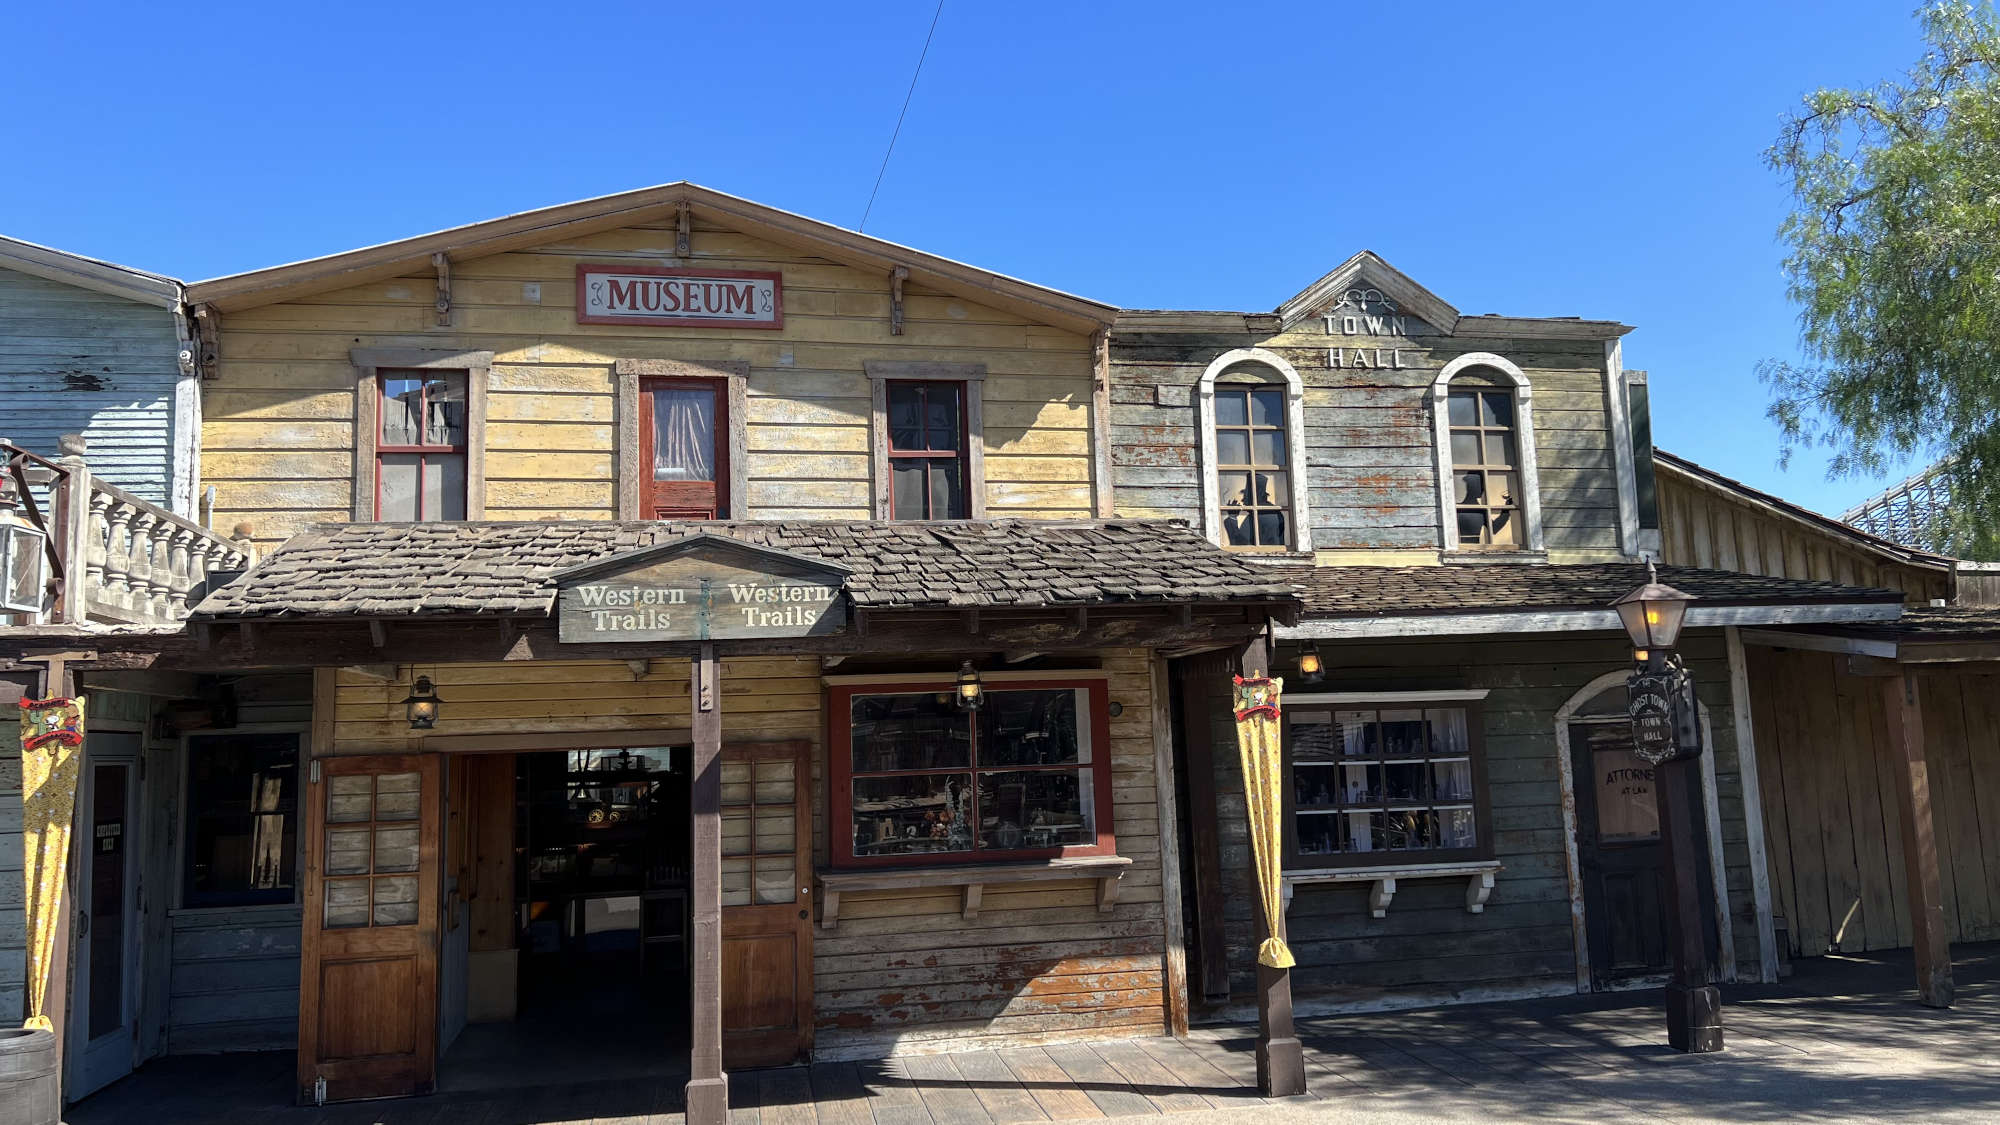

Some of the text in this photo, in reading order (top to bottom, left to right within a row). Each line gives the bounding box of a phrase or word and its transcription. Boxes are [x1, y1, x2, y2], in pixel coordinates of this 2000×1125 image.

[606, 279, 757, 315] MUSEUM
[1324, 315, 1406, 335] TOWN
[1329, 348, 1405, 367] HALL
[577, 585, 687, 607] Western
[728, 583, 832, 604] Western
[591, 609, 672, 632] Trails
[741, 606, 818, 628] Trails
[1629, 693, 1670, 716] GHOST TOWN
[1641, 717, 1661, 728] TOWN
[1643, 732, 1662, 741] HALL
[1606, 768, 1656, 785] ATTORNE
